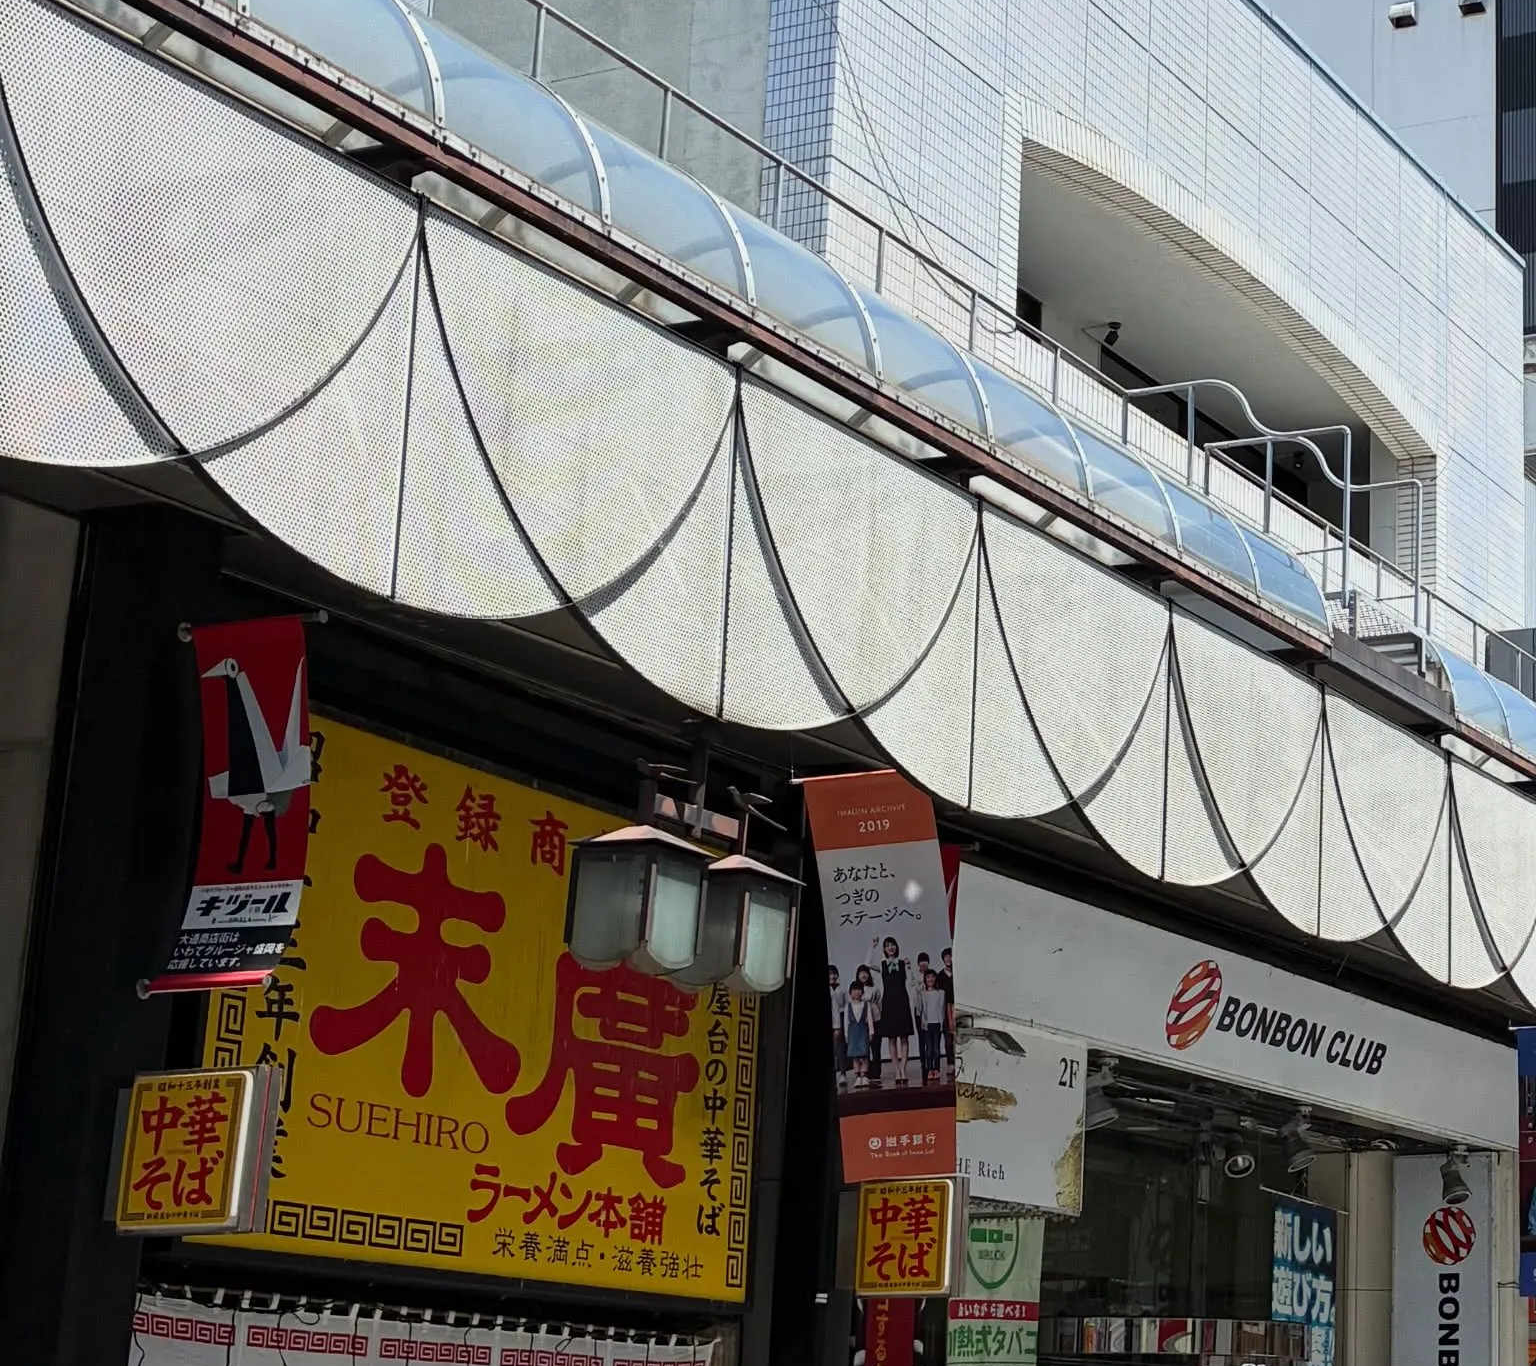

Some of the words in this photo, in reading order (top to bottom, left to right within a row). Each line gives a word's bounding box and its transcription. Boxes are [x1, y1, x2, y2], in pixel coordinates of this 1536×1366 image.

[381, 763, 568, 876] 登録商
[859, 819, 890, 832] 2019
[833, 863, 895, 883] あなたと、
[835, 889, 880, 905] つぎの
[840, 907, 921, 926] ステージへ。
[309, 842, 701, 1188] 末廣
[1216, 995, 1325, 1057] BONBON
[1327, 1030, 1387, 1077] CLUB
[1058, 1057, 1080, 1088] 2F
[142, 1091, 228, 1155] 中華
[306, 1093, 491, 1155] SUEHIRO
[132, 1150, 224, 1210] そば
[978, 1161, 1005, 1180] Rich
[869, 1195, 938, 1241] 中華
[1274, 1210, 1332, 1264] 新しい
[867, 1237, 936, 1281] そば
